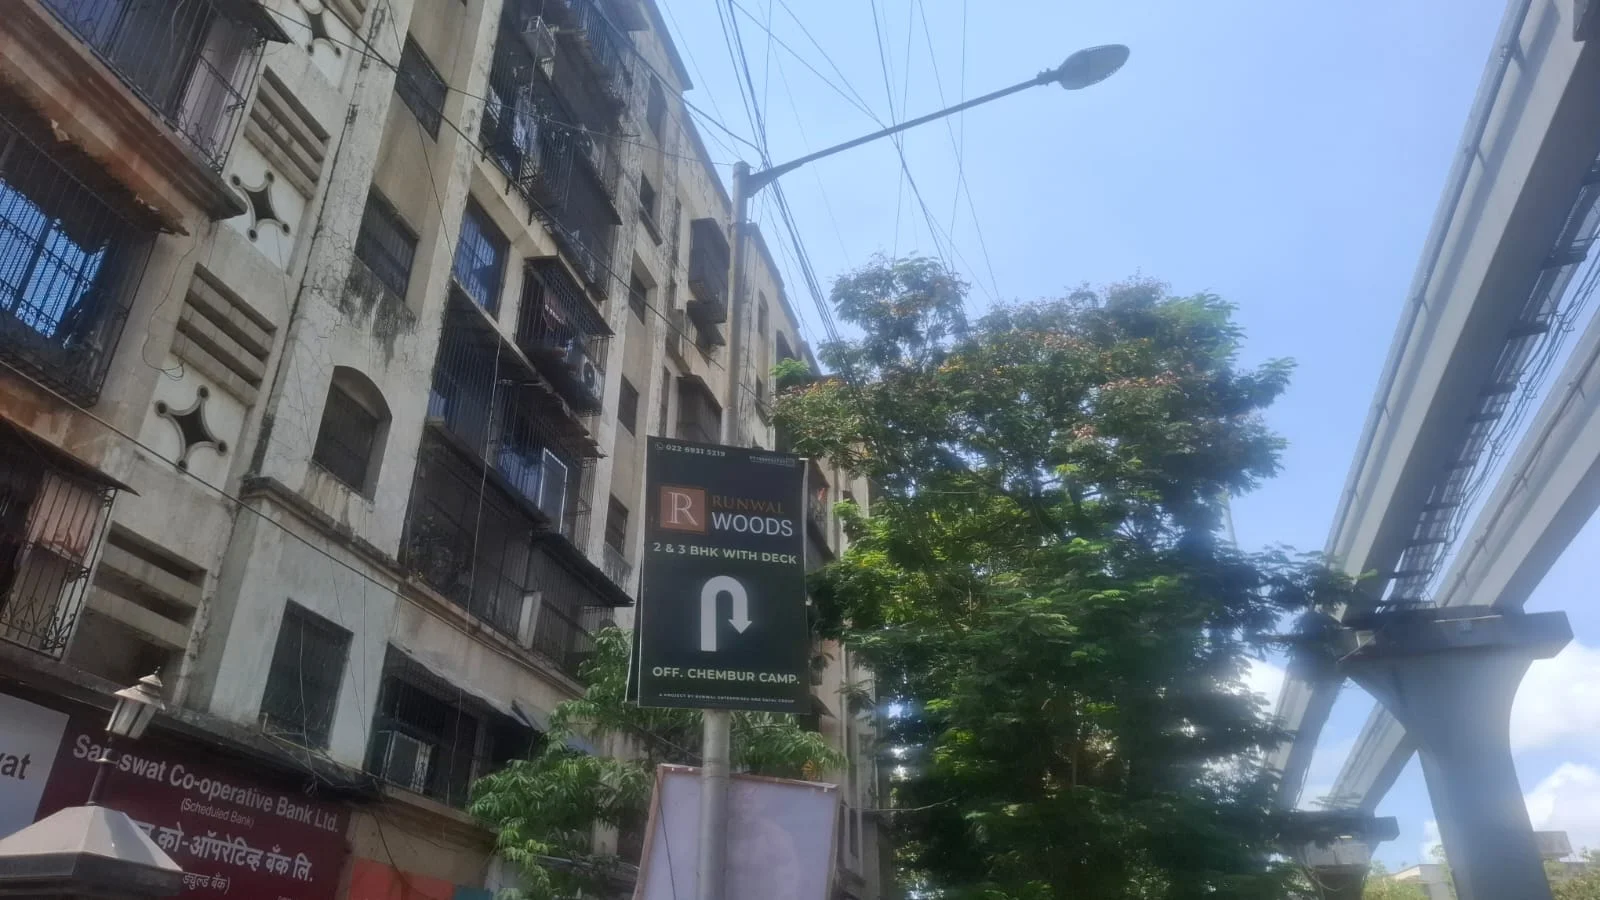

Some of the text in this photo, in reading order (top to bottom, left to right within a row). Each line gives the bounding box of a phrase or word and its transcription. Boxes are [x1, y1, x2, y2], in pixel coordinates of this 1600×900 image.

[666, 444, 682, 452] 022
[665, 491, 699, 526] R
[712, 495, 784, 514] RUNWAL
[712, 511, 793, 537] WOODS
[653, 542, 797, 564] 2 & 3 BHK WITH DECK
[652, 666, 800, 685] OFF. CHEMBUR CAMP.
[0, 751, 31, 780] at
[73, 734, 339, 833] Sarswat Co-operative Bank Ltd.
[180, 798, 255, 829] (Scheduled Bank)
[293, 853, 314, 883] लि.
